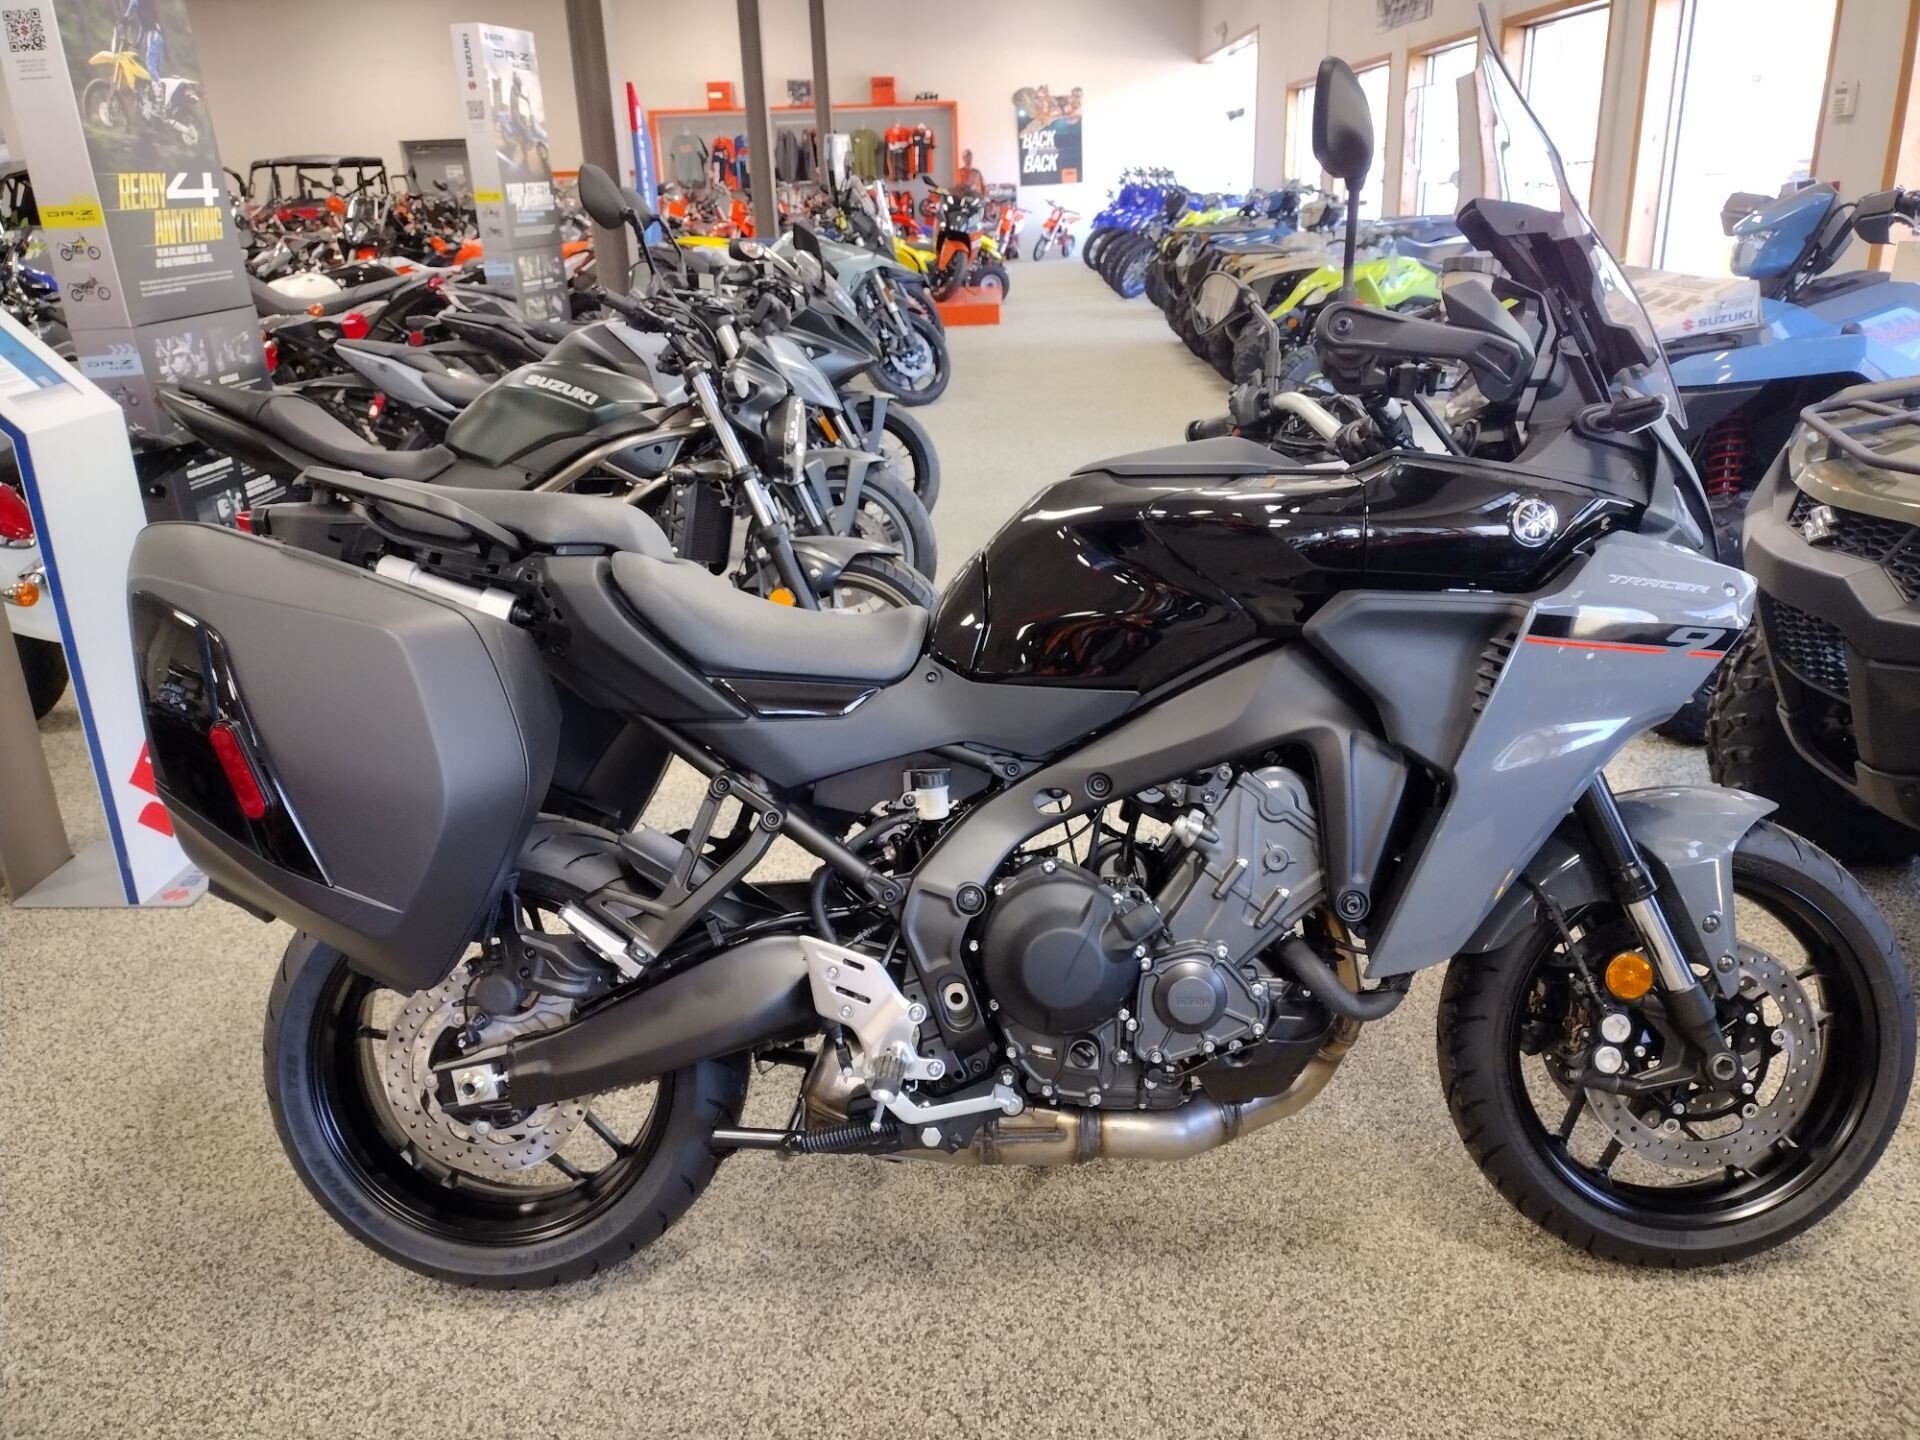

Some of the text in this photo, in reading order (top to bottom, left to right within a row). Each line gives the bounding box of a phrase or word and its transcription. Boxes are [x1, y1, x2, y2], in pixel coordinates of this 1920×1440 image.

[462, 33, 474, 77] SUZUKI
[1022, 129, 1057, 149] BACK
[1023, 153, 1059, 174] BACK
[118, 172, 219, 210] READY 4
[46, 209, 94, 218] DR-Z
[154, 207, 224, 246] ANYTHING
[1698, 310, 1753, 328] SUZUKI
[524, 374, 599, 406] SUZUKI
[1607, 573, 1711, 595] TRACER
